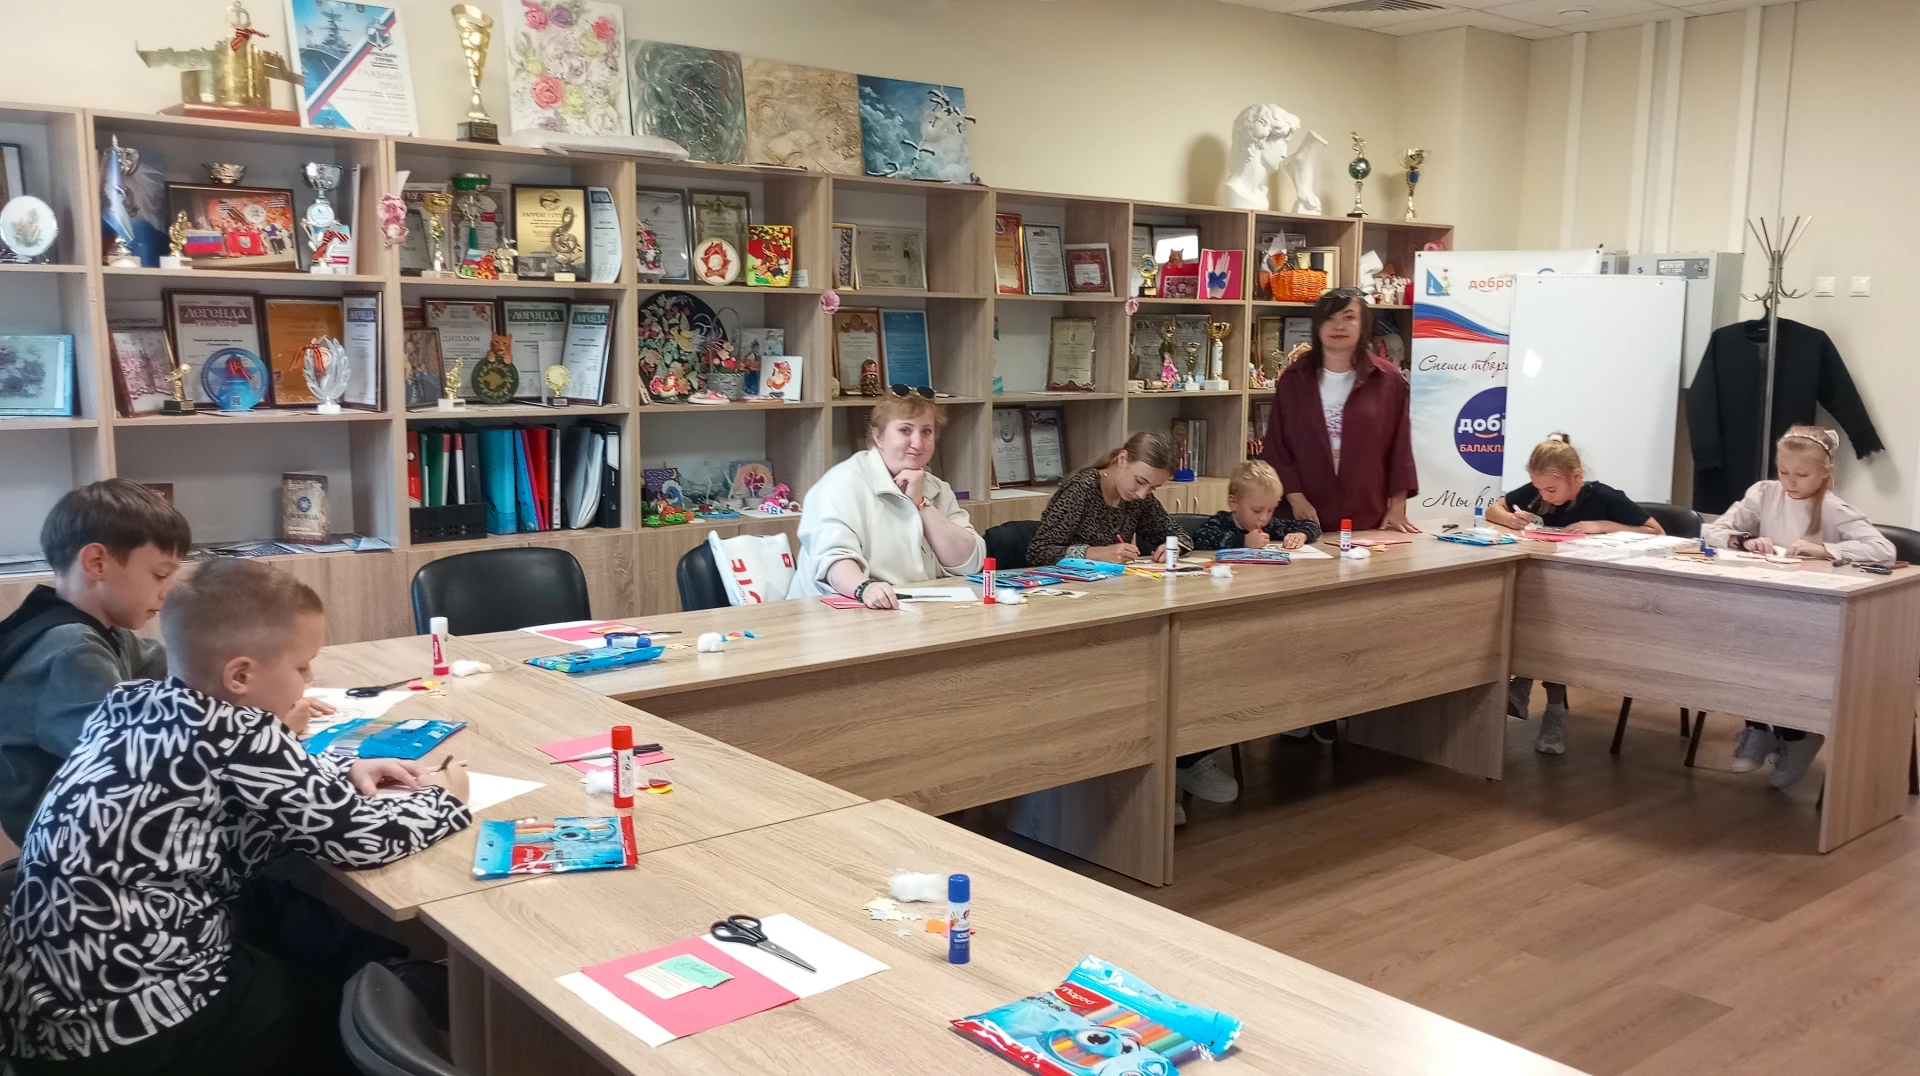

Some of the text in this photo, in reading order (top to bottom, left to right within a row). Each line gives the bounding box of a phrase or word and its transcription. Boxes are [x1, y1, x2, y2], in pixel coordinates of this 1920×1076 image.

[358, 68, 403, 81] ГЛАВНЫЙ
[379, 82, 404, 92] ПРИЗ
[442, 335, 481, 343] ДИПЛОМ
[1418, 354, 1467, 372] Спеши
[1422, 490, 1469, 508] Мы
